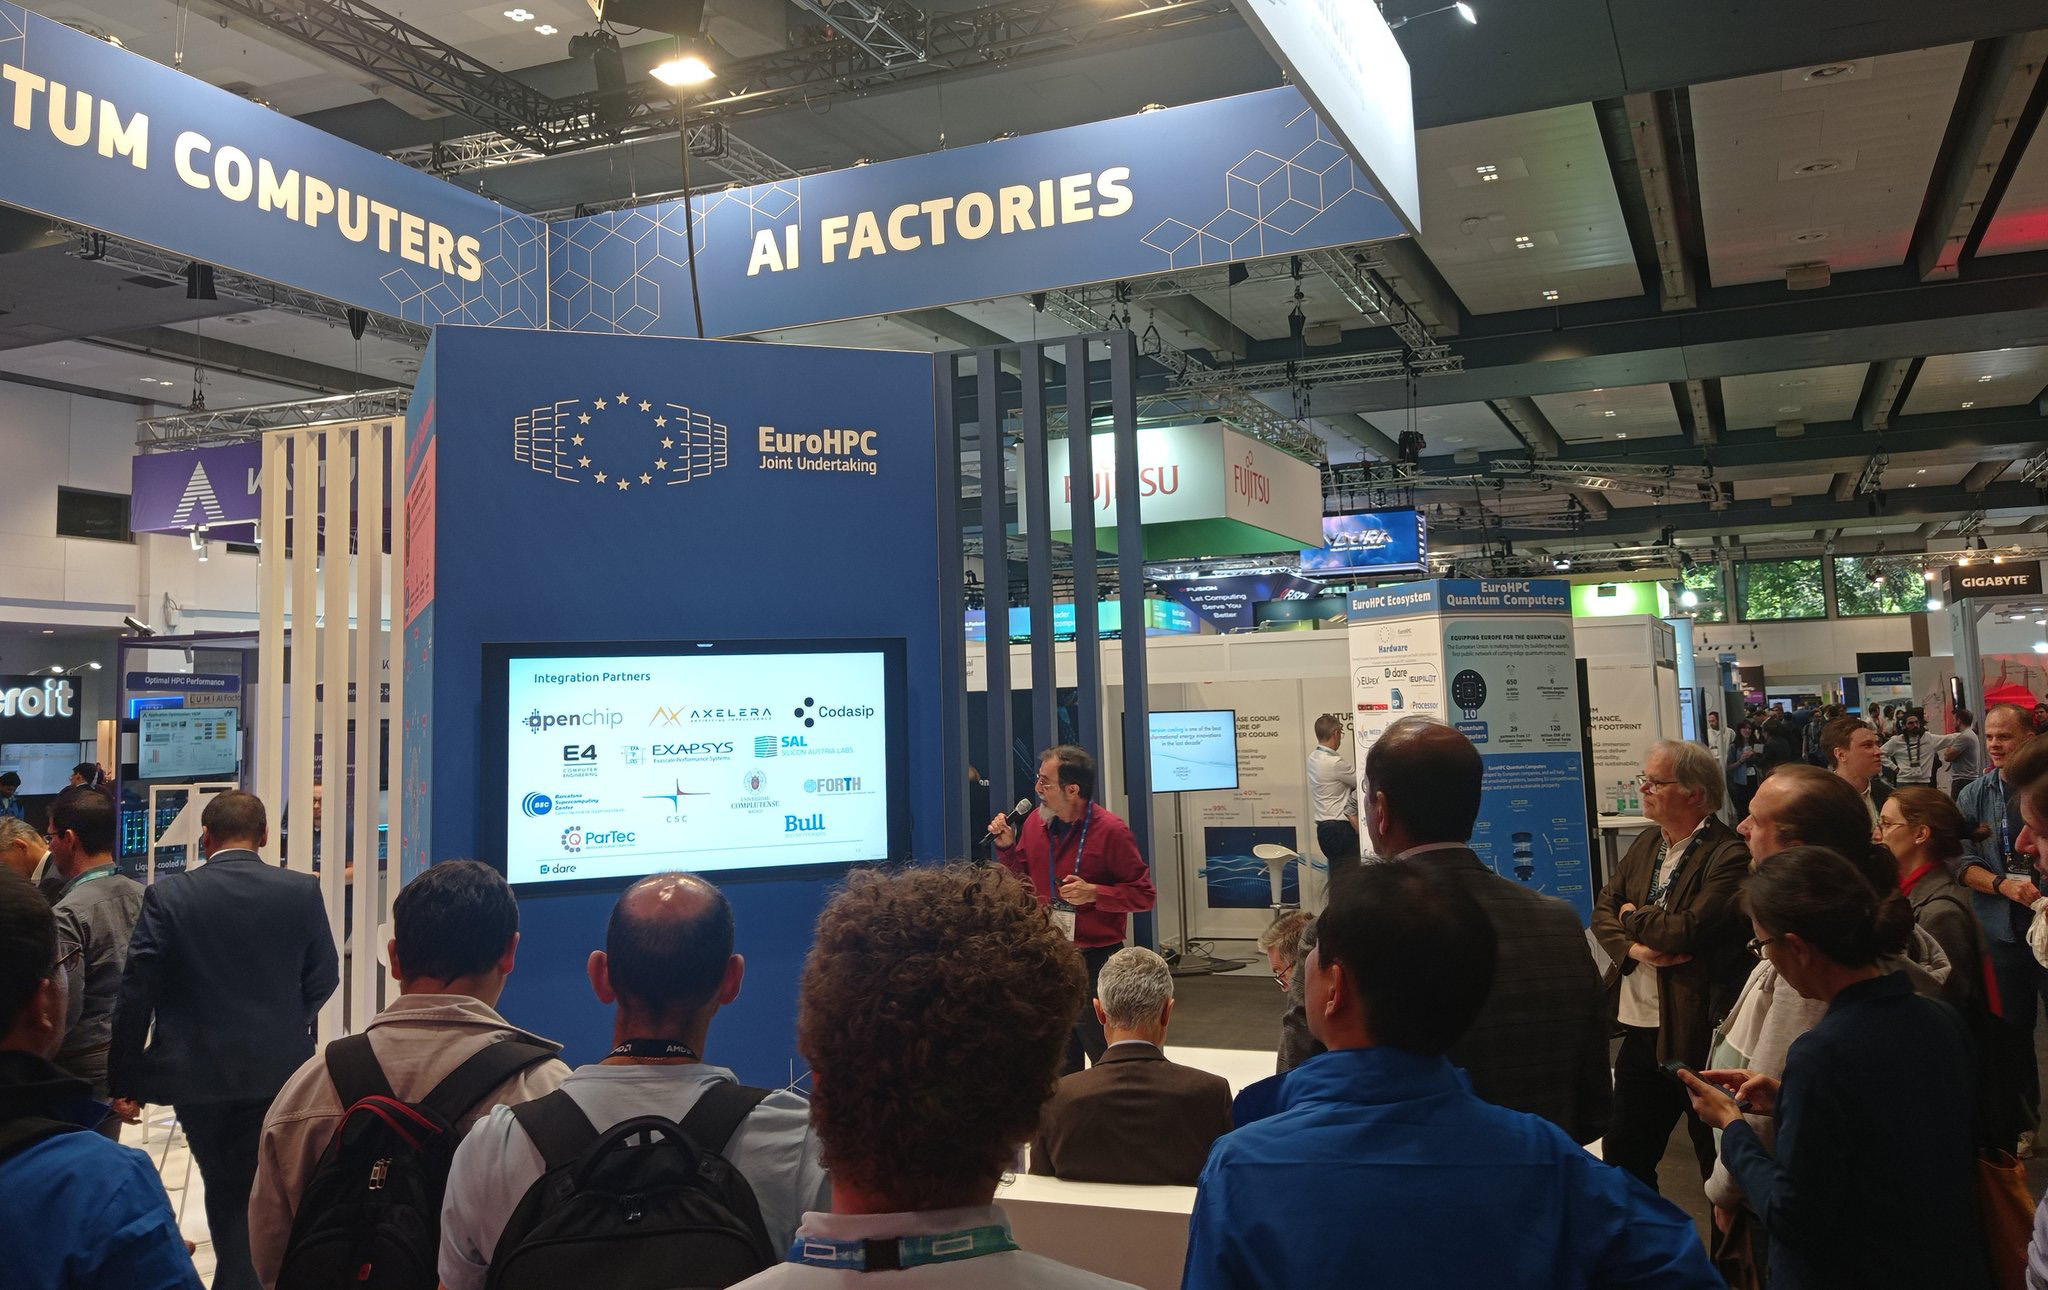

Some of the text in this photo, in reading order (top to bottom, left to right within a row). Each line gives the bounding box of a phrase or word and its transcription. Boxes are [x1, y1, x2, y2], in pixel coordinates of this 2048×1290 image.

[3, 63, 482, 282] TUM COMPUTERS
[747, 167, 1134, 277] AI FACTORIES
[759, 426, 878, 456] EuroHPC
[759, 456, 877, 475] Joint Undertaking
[1481, 582, 1530, 593] EuroHPC
[1962, 575, 2028, 588] GIGABYTE
[1203, 593, 1246, 602] Computing
[1352, 592, 1431, 610] EuroHPC Ecosystem
[1446, 594, 1565, 608] Quantum Computers
[1379, 644, 1408, 654] Hardware
[534, 672, 651, 684] Integration Partners
[1392, 668, 1408, 678] dare
[145, 676, 170, 684] Optimal
[186, 678, 225, 686] Performance
[818, 705, 874, 719] Codasip
[1412, 701, 1438, 710] Processor
[527, 708, 624, 732] openchip
[1464, 709, 1477, 719] 10
[781, 736, 808, 748] SAL
[563, 744, 598, 761] E4
[652, 742, 734, 756] EXAPSYS
[817, 777, 862, 792] FORTH
[730, 801, 780, 810] COMPLUTENSE
[784, 814, 826, 832] Bull
[586, 831, 636, 844] ParTec
[552, 863, 577, 874] dare
